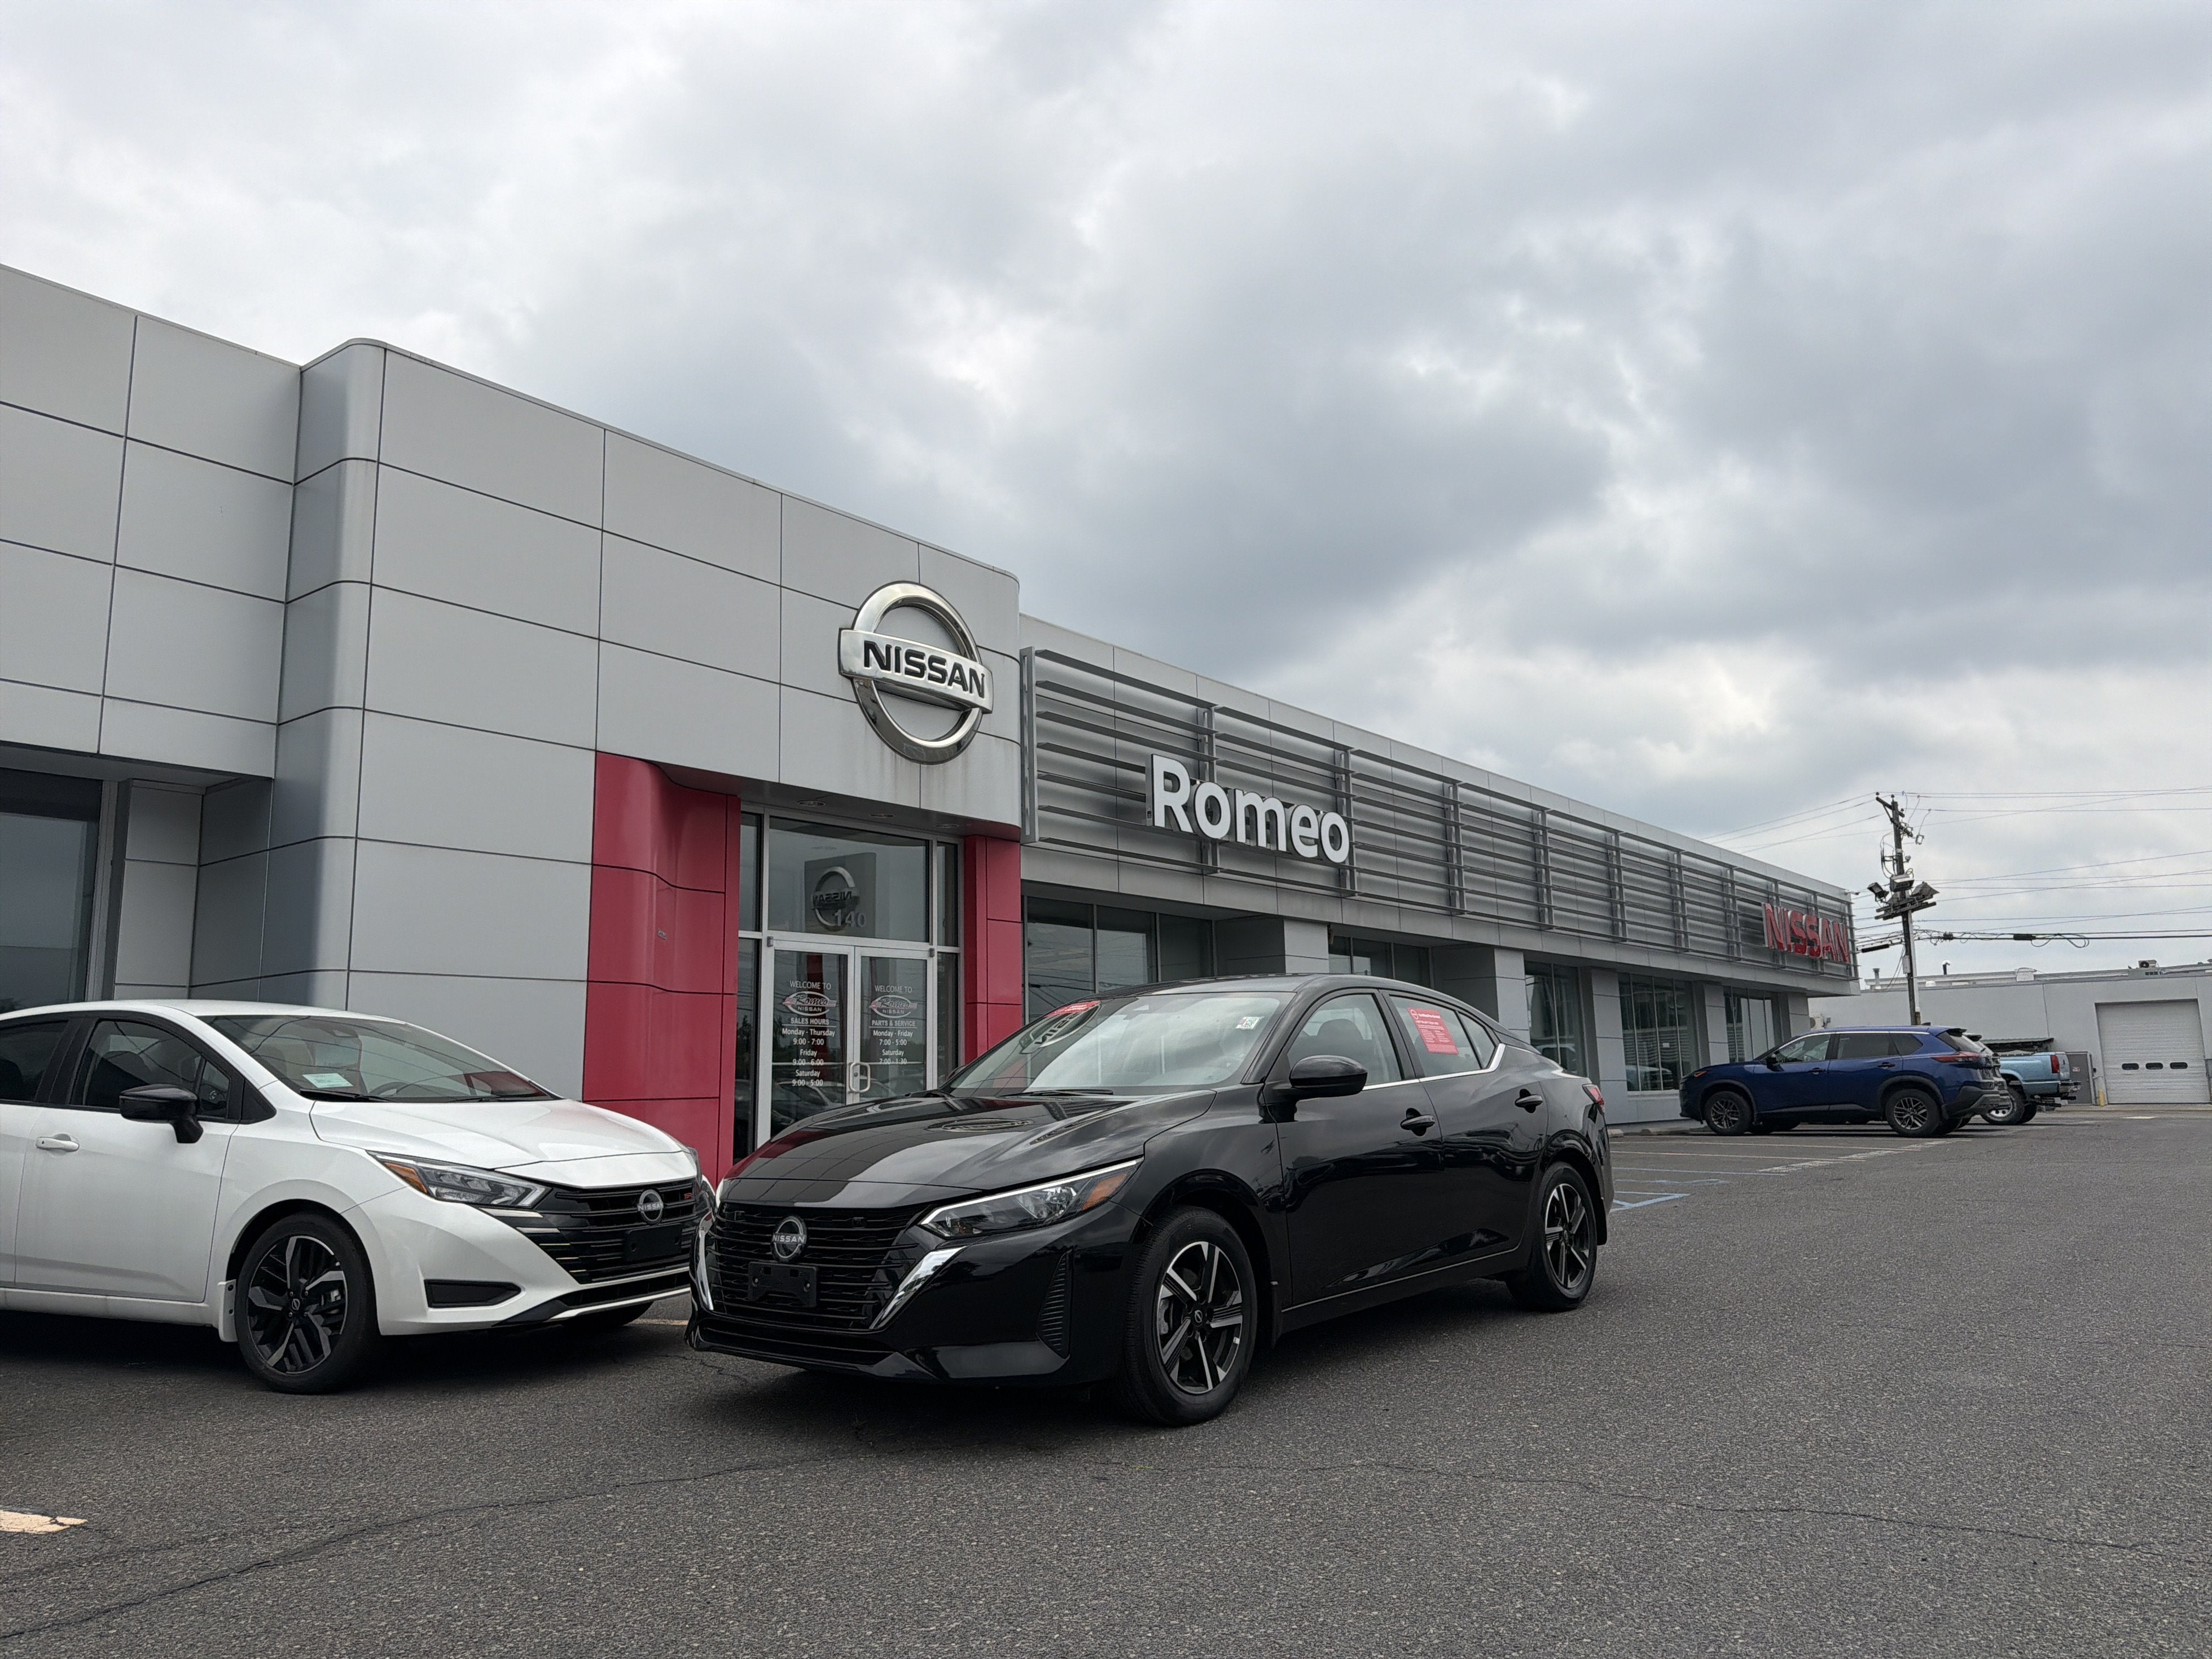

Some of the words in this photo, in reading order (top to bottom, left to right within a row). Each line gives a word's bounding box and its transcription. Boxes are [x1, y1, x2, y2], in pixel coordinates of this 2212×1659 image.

[863, 640, 985, 699] NISSAN
[1151, 753, 1350, 864] Romeo
[834, 909, 866, 928] 140
[1762, 902, 1850, 964] NISSAN
[789, 980, 821, 990] WELCOME
[793, 993, 828, 1006] Romeo
[879, 997, 910, 1009] Romeo
[782, 1028, 805, 1036] Monday
[809, 1028, 836, 1037] Thursday
[873, 1030, 894, 1038] Monday
[898, 1030, 913, 1038] Friday
[799, 1048, 818, 1058] Friday
[882, 1048, 905, 1057] Saturday
[795, 1069, 821, 1078] Saturday
[772, 1234, 805, 1243] NISSAN
